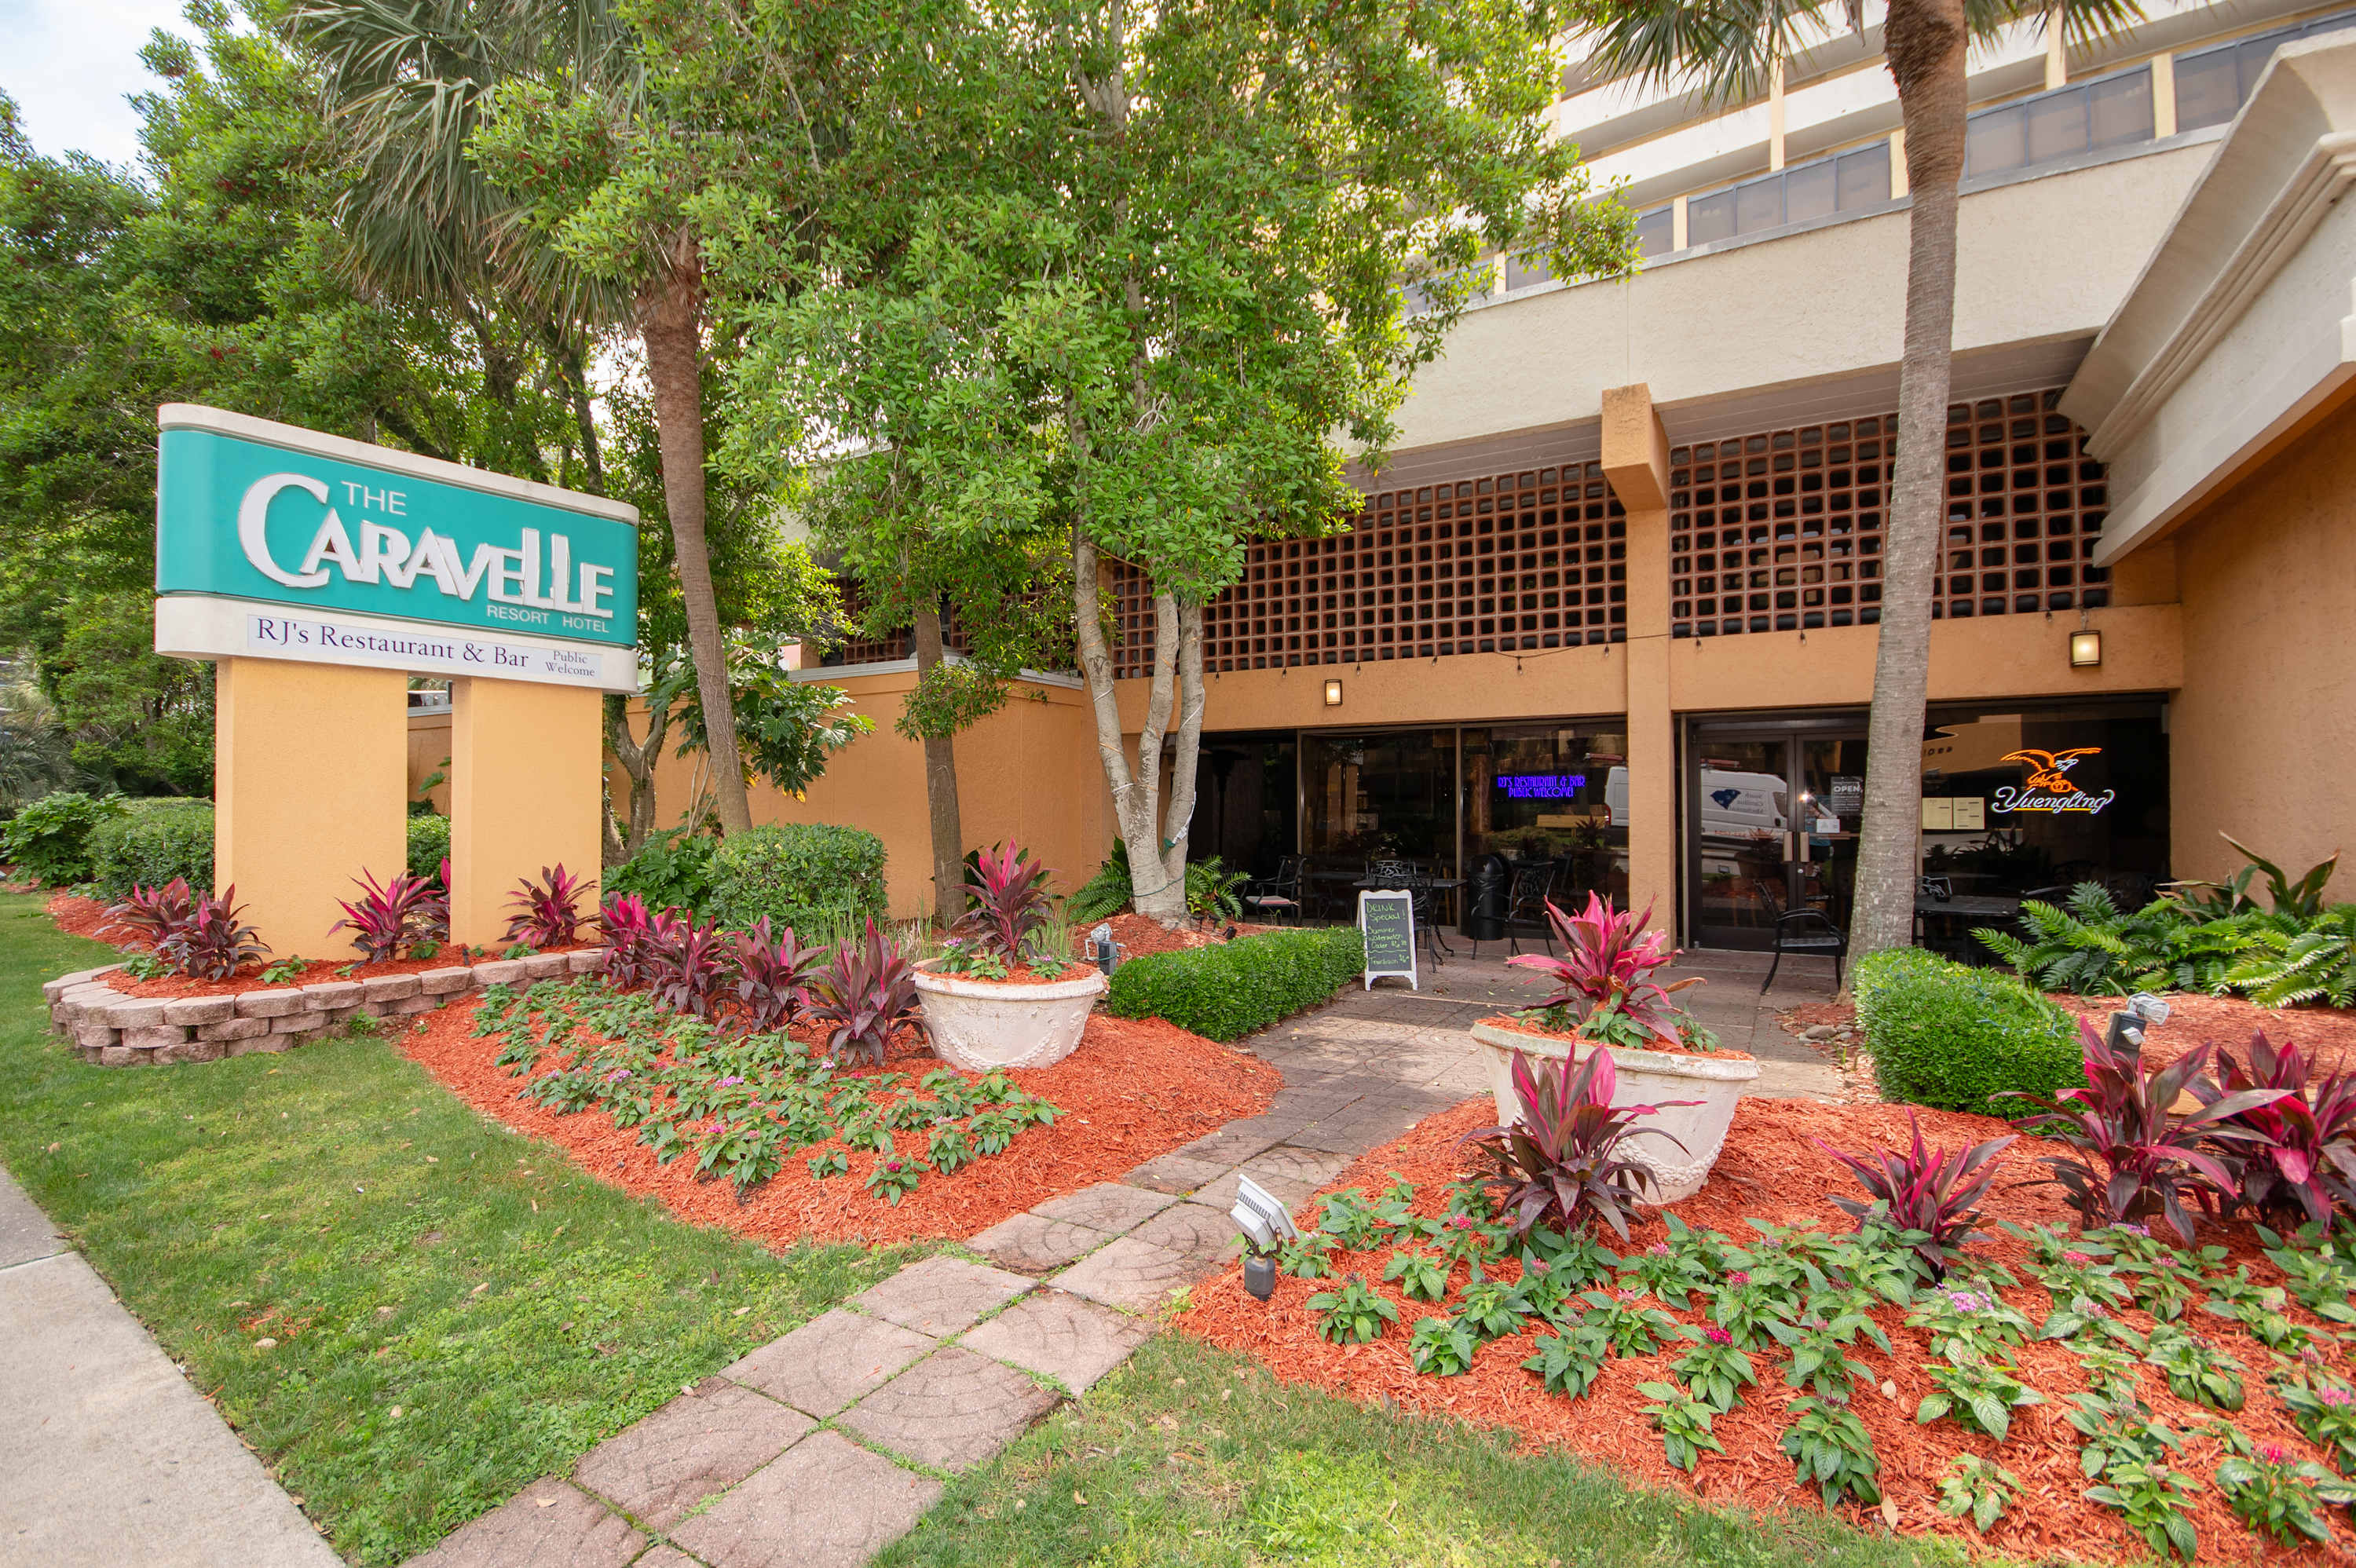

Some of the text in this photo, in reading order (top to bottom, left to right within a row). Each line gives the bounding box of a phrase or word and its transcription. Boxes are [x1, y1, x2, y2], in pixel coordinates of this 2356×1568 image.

[341, 480, 408, 517] THE
[237, 471, 615, 619] CARAVELLE
[486, 605, 610, 634] RESORT HOTEL
[257, 617, 529, 668] RJ's Restaurant & Bar
[552, 650, 587, 664] Public
[545, 660, 596, 678] Welcome
[1498, 776, 1586, 788] RJ'S RESTAURANT & BAR
[1509, 788, 1574, 798] PUBLIC WELCOME!
[1834, 784, 1860, 793] OPEN
[1991, 785, 2116, 814] Yuengling
